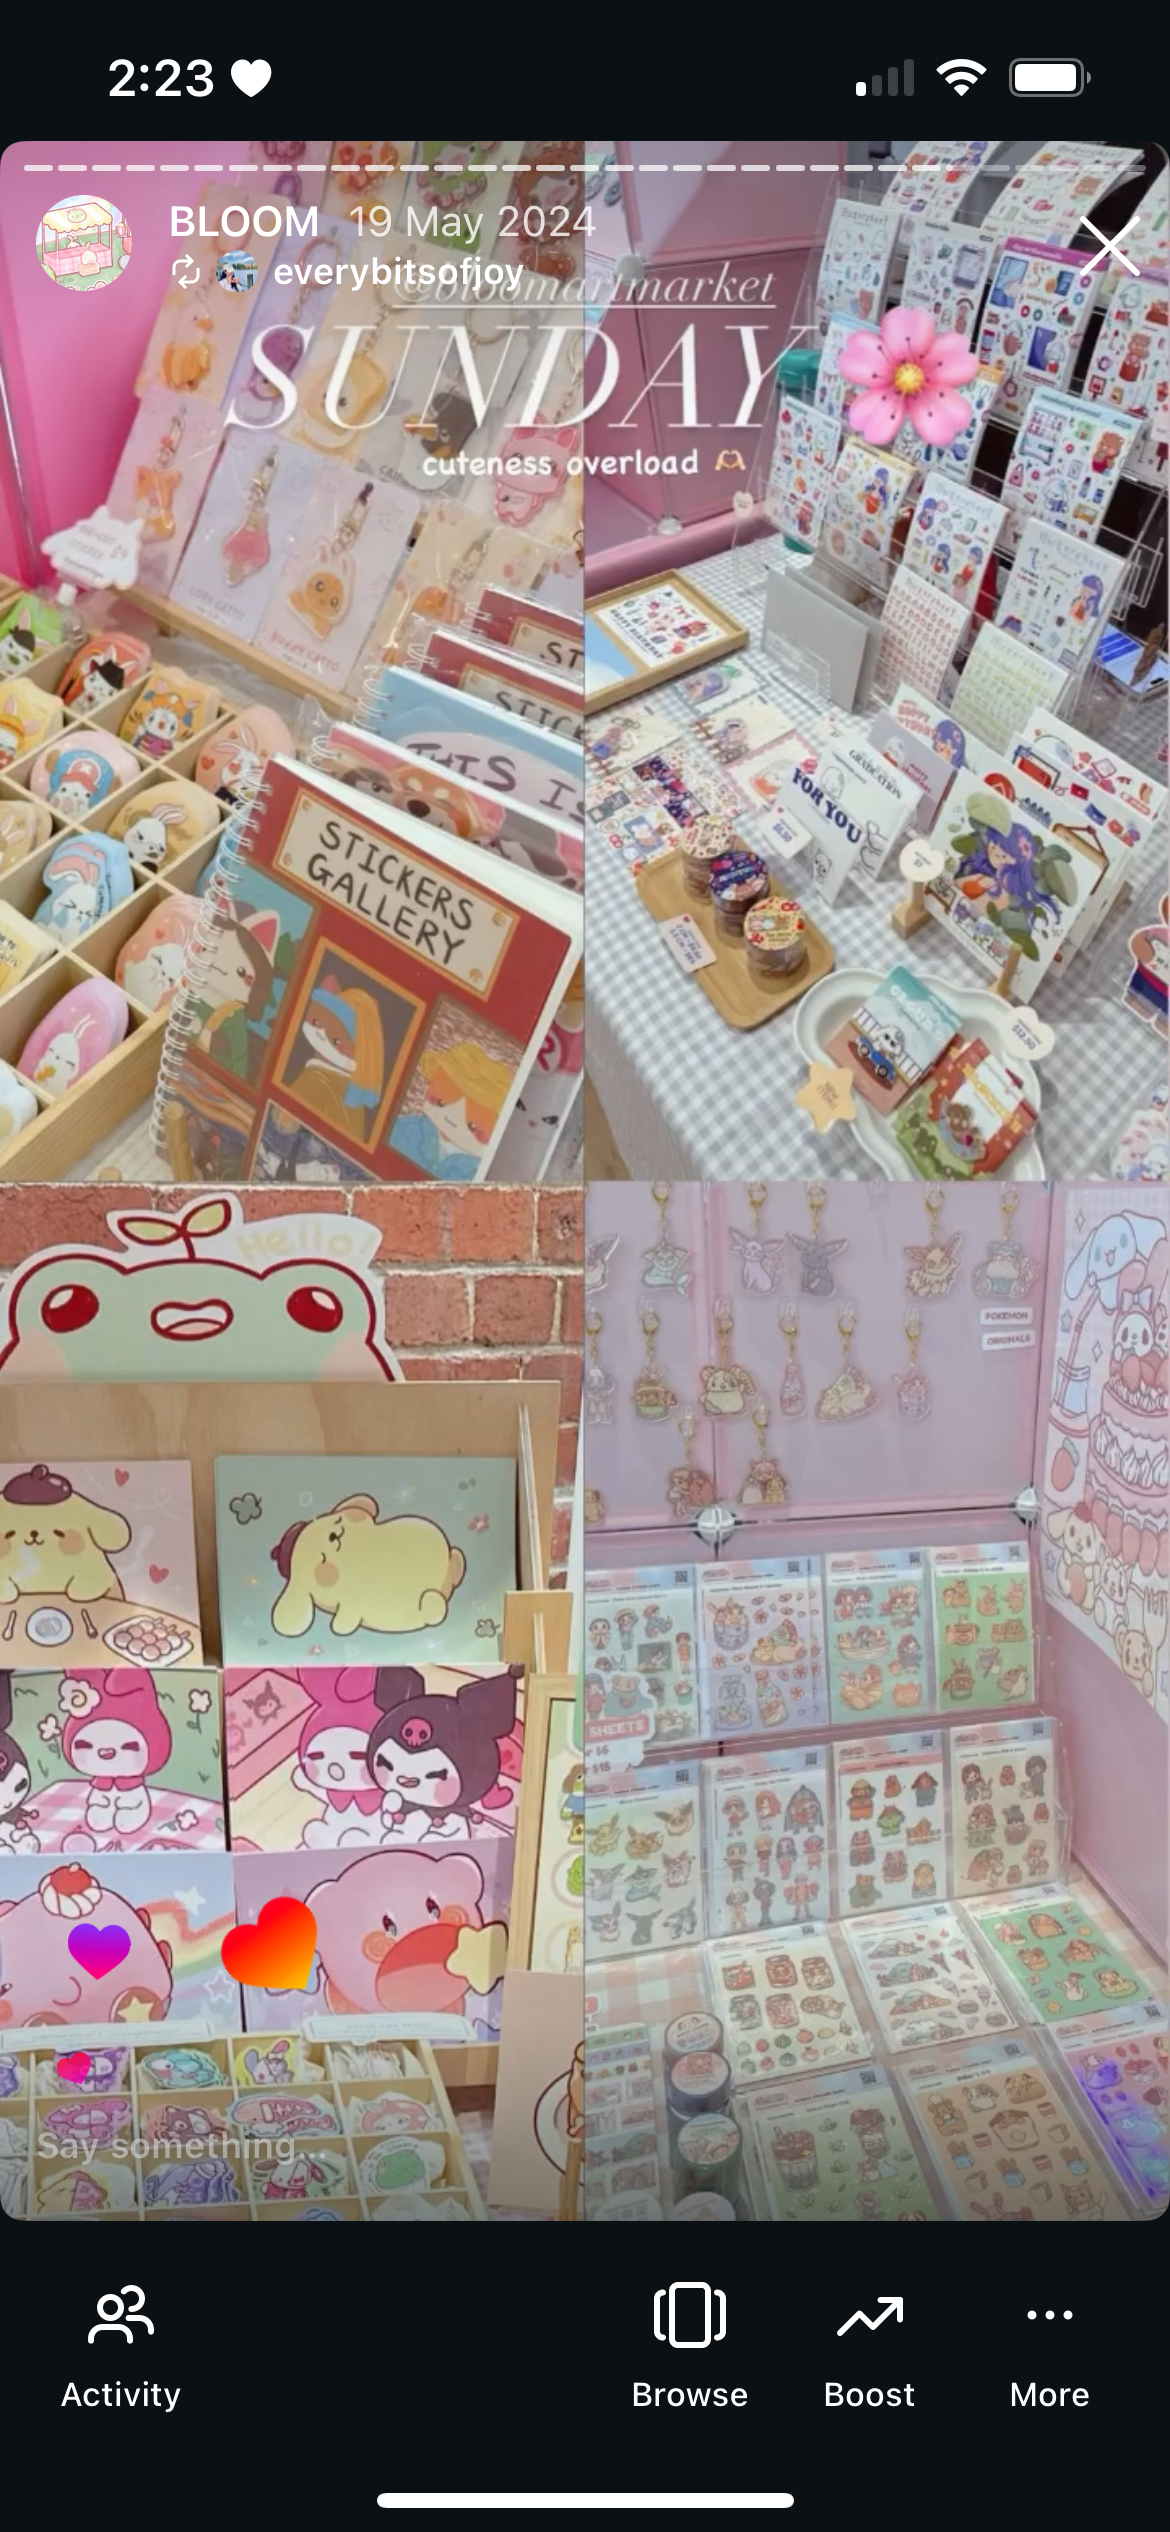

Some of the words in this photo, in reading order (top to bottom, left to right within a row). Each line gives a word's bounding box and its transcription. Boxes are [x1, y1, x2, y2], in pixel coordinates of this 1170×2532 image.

[792, 767, 825, 807] FOR
[825, 799, 862, 844] YOU
[319, 820, 474, 931] STICKERS
[307, 852, 466, 965] GALLERY
[985, 1311, 1029, 1321] POKEMON
[987, 1333, 1031, 1346] ORIGINALS
[589, 1719, 646, 1738] SHEETS
